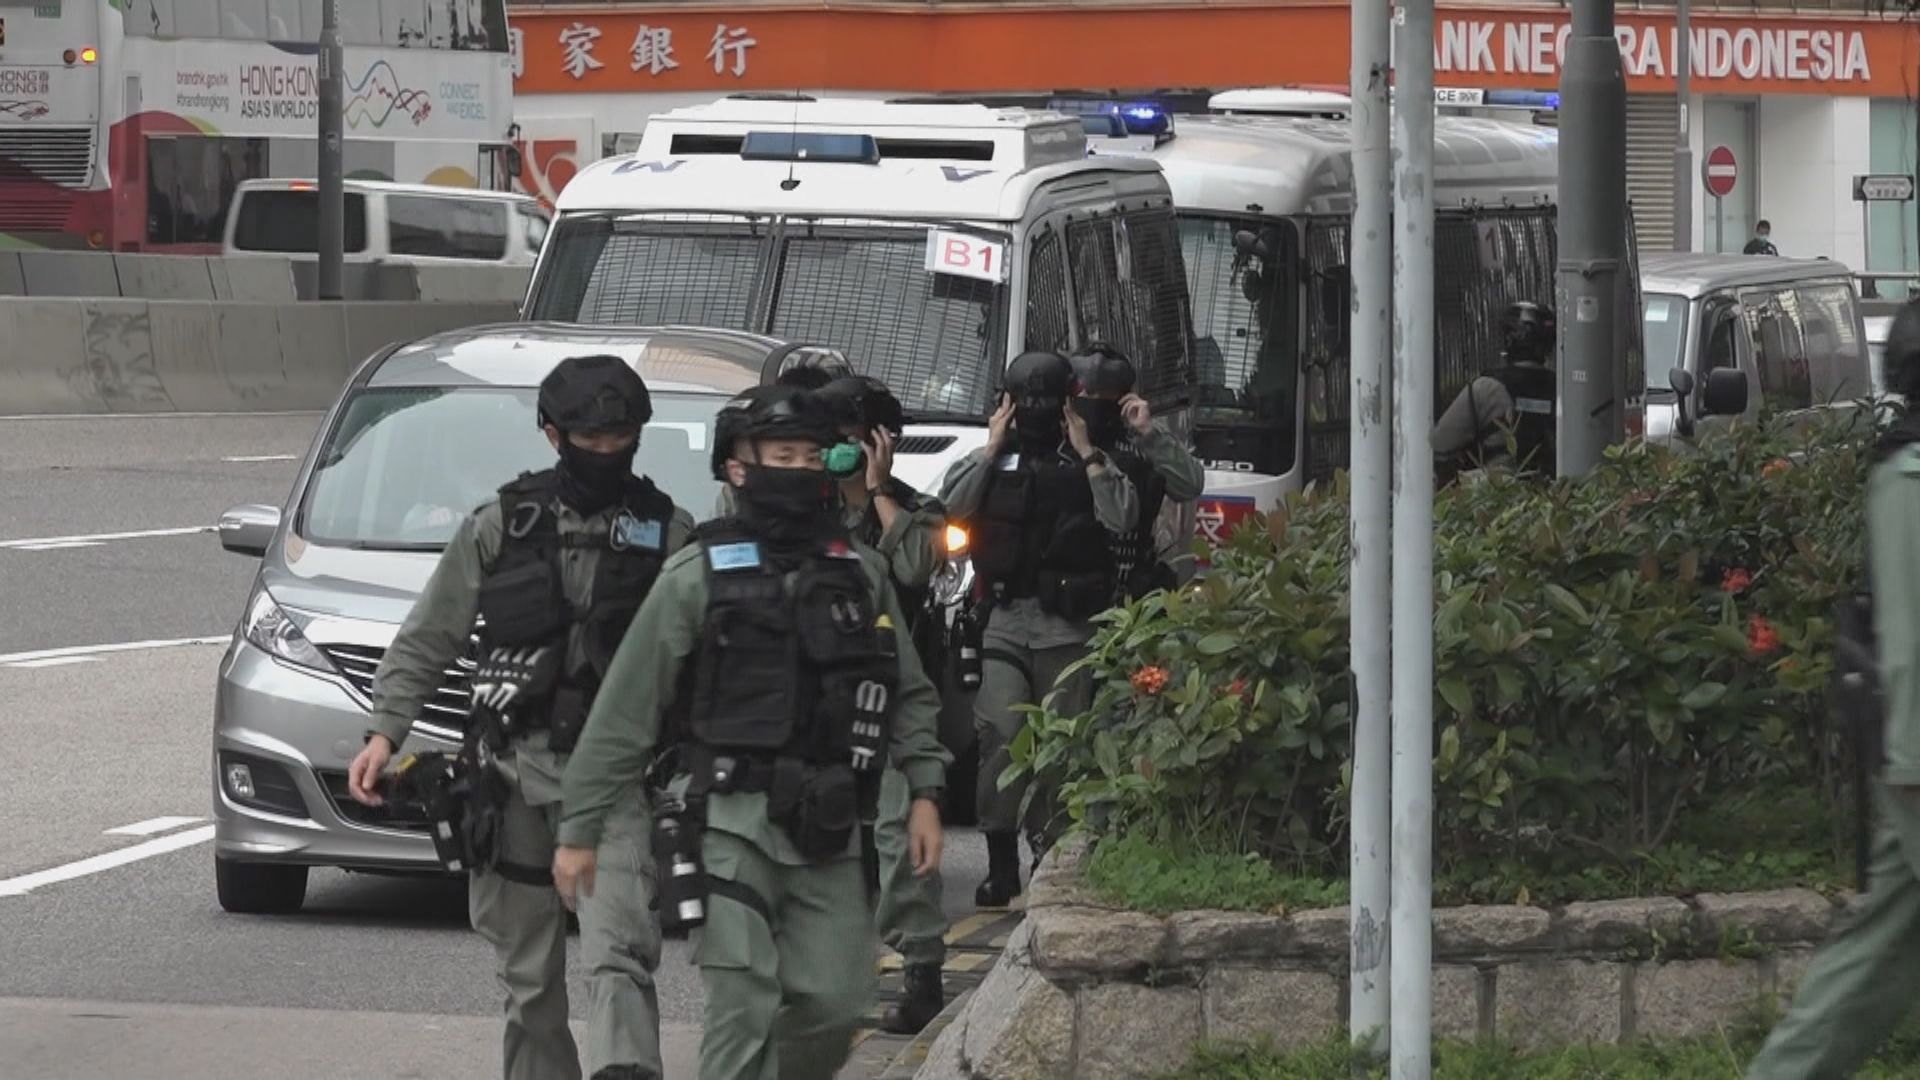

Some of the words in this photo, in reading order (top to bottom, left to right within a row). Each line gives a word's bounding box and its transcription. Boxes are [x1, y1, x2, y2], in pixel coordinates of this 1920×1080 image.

[240, 65, 284, 96] HONG
[286, 65, 318, 96] KON
[273, 100, 306, 119] WORLD
[944, 239, 993, 273] B1
[1200, 459, 1254, 472] USO
